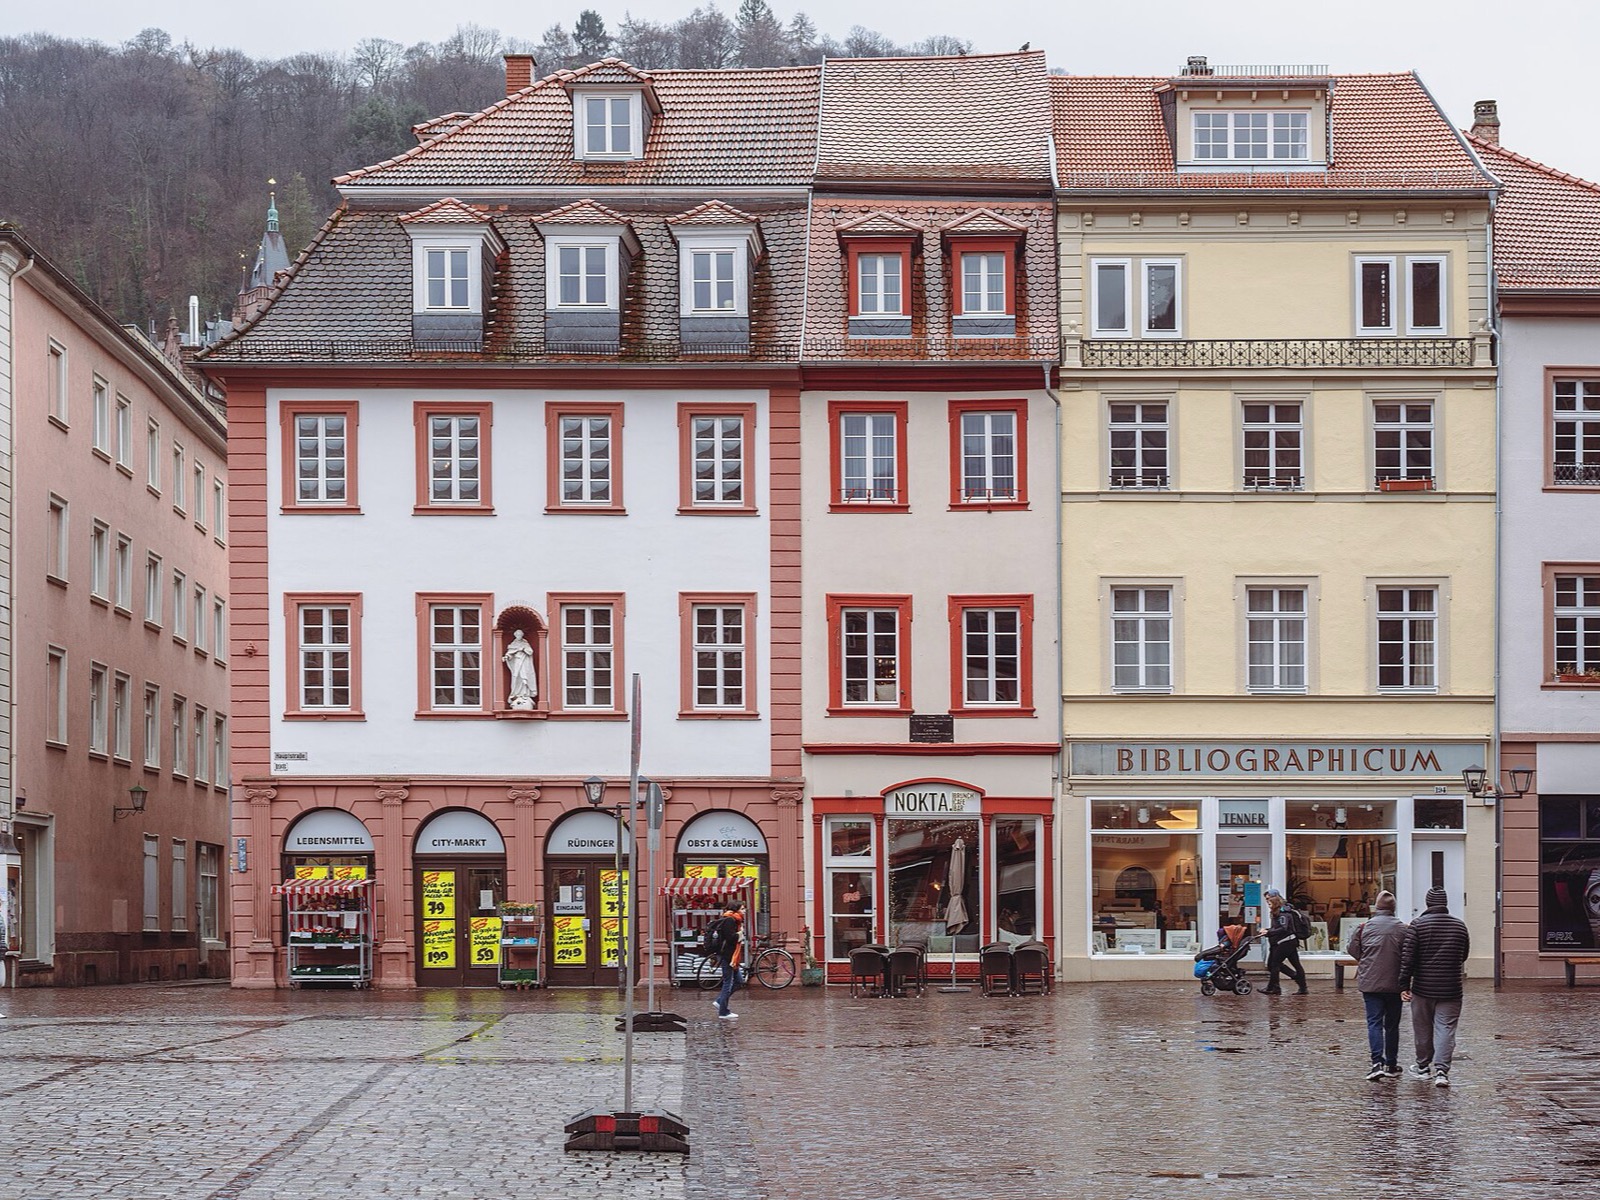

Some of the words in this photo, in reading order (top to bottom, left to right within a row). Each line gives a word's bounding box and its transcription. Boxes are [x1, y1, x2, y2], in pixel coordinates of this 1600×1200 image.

[1117, 748, 1442, 772] BIBLIOGRAPHICUM
[1223, 813, 1265, 824] TENNER
[297, 837, 365, 845] LEBENSMITTEL
[567, 836, 615, 847] RÜDINGER
[687, 839, 711, 847] OBST
[720, 838, 758, 847] GEMÜSE
[1546, 931, 1574, 941] PRX
